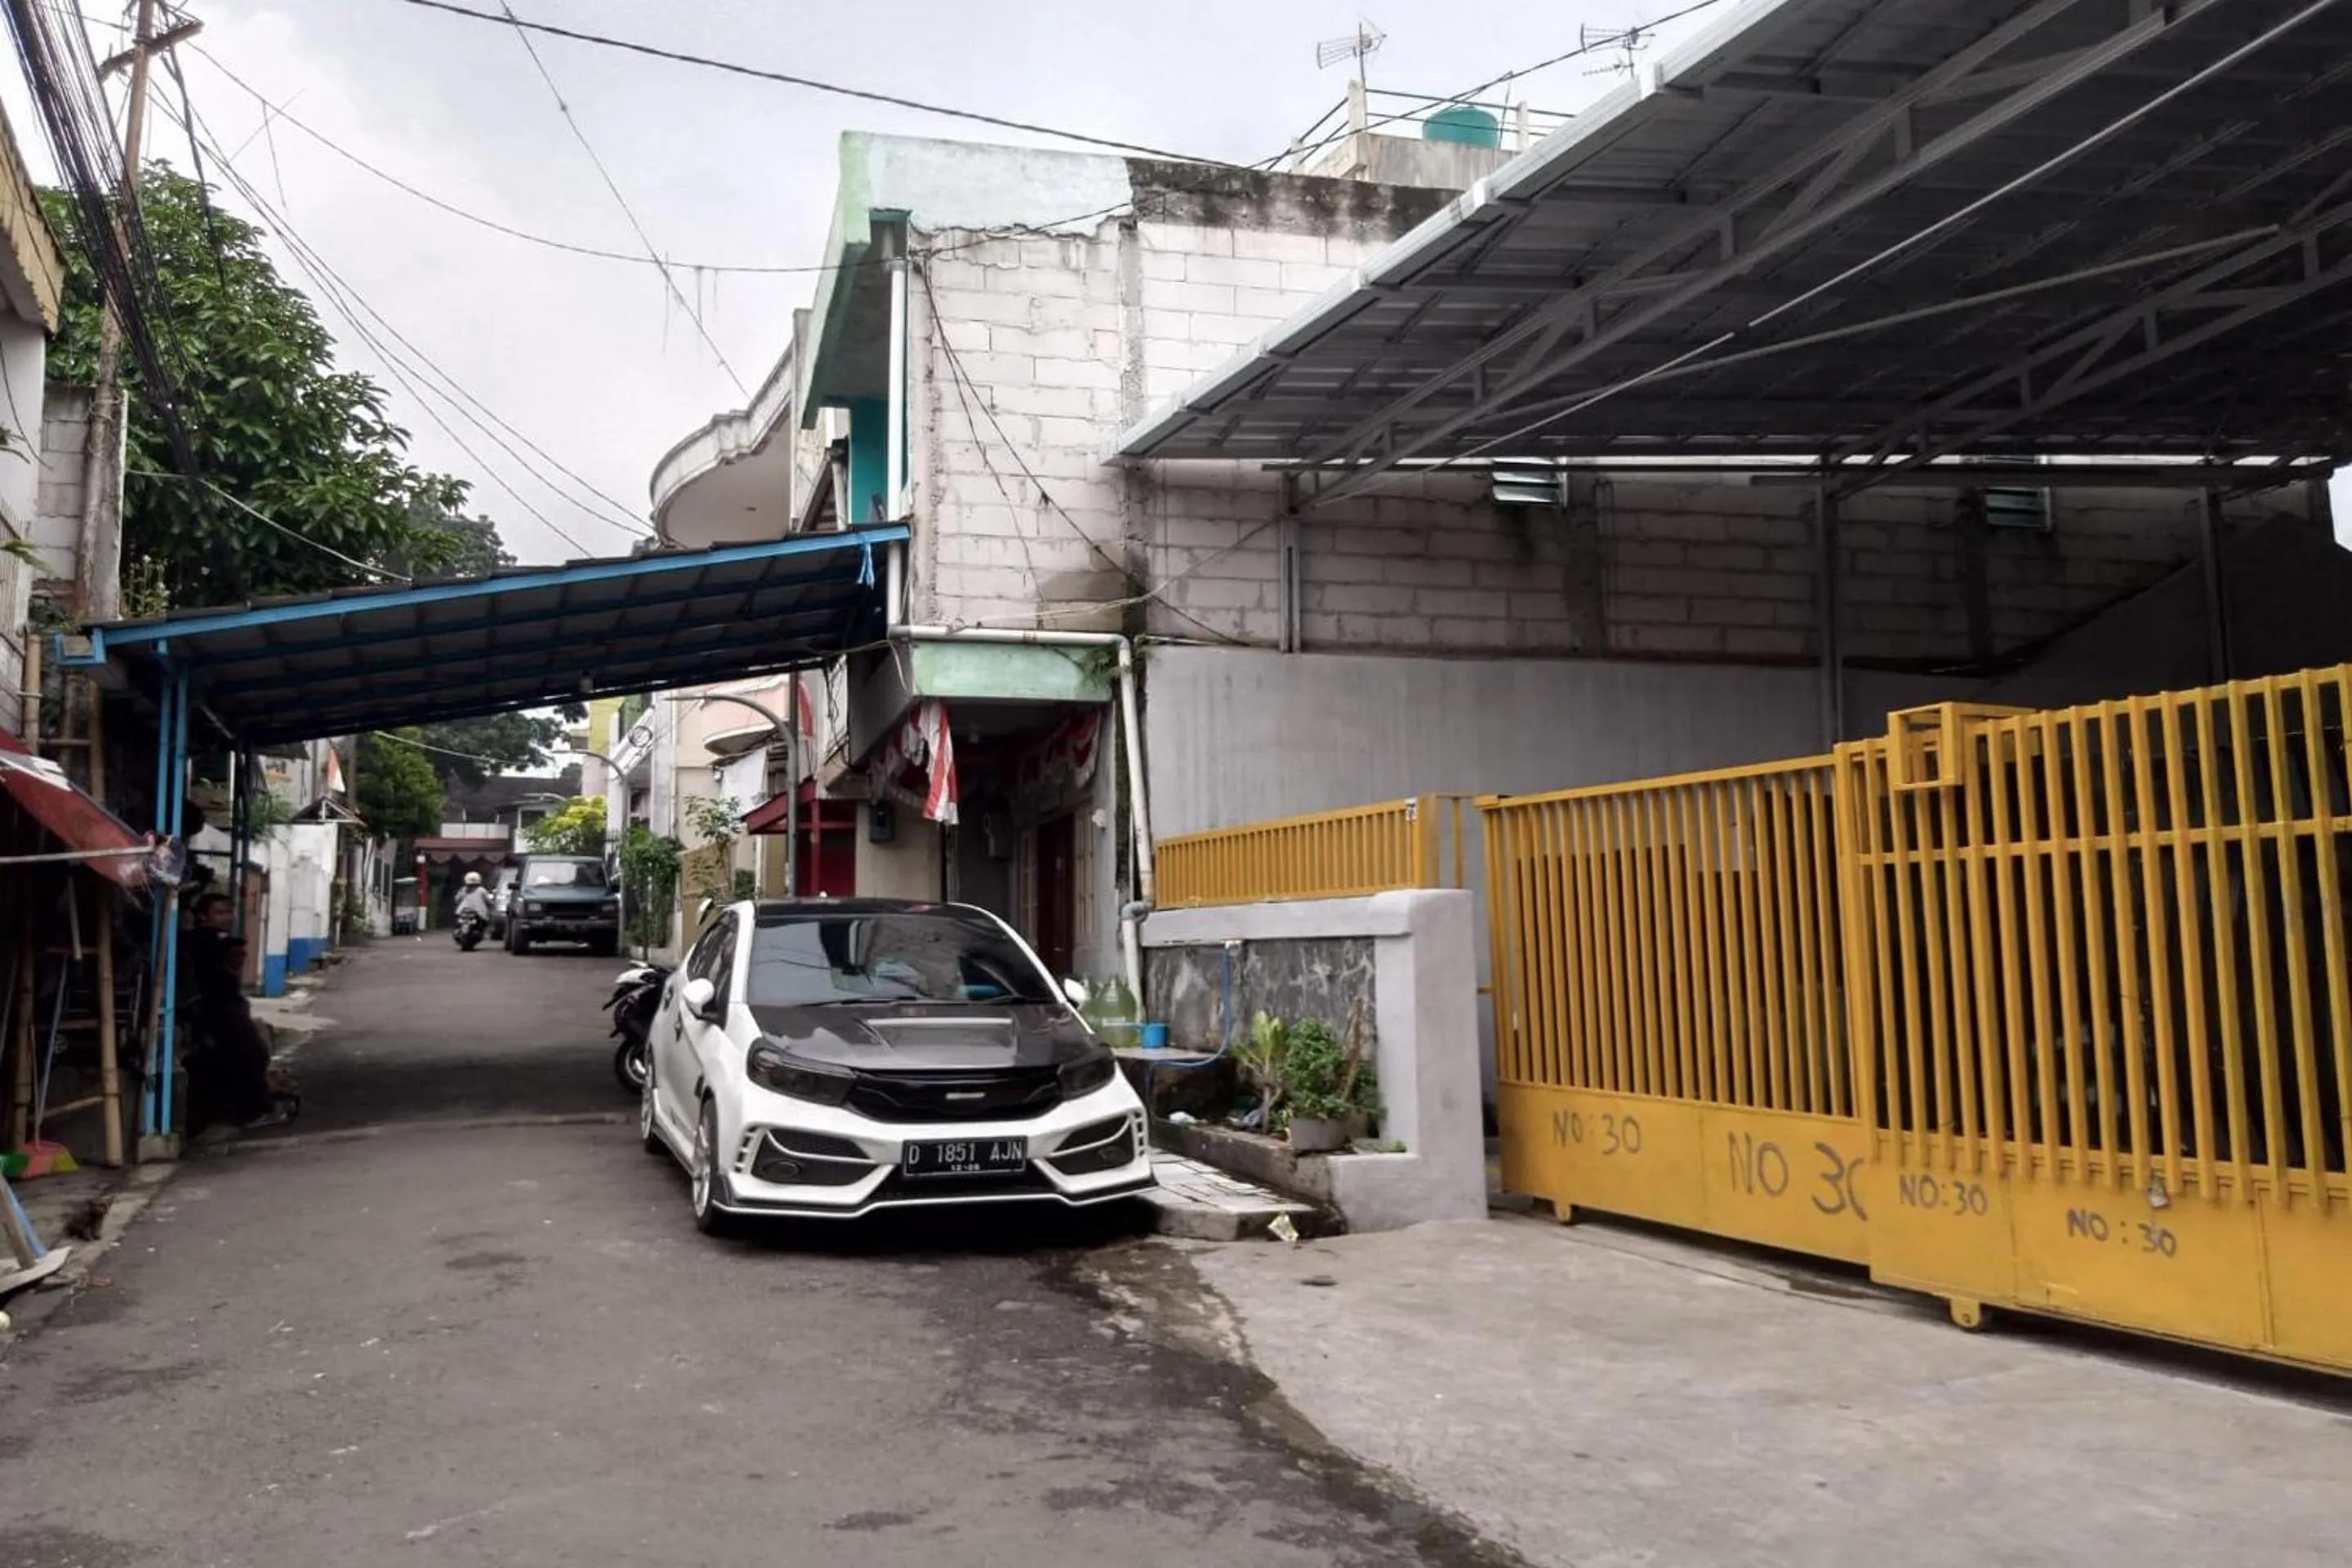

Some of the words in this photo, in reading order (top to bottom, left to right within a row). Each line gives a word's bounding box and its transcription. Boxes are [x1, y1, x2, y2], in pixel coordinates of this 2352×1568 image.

[908, 1145, 920, 1165] D
[937, 1143, 976, 1163] 1851
[990, 1142, 1022, 1160] AJN
[1727, 1131, 1788, 1197] NO
